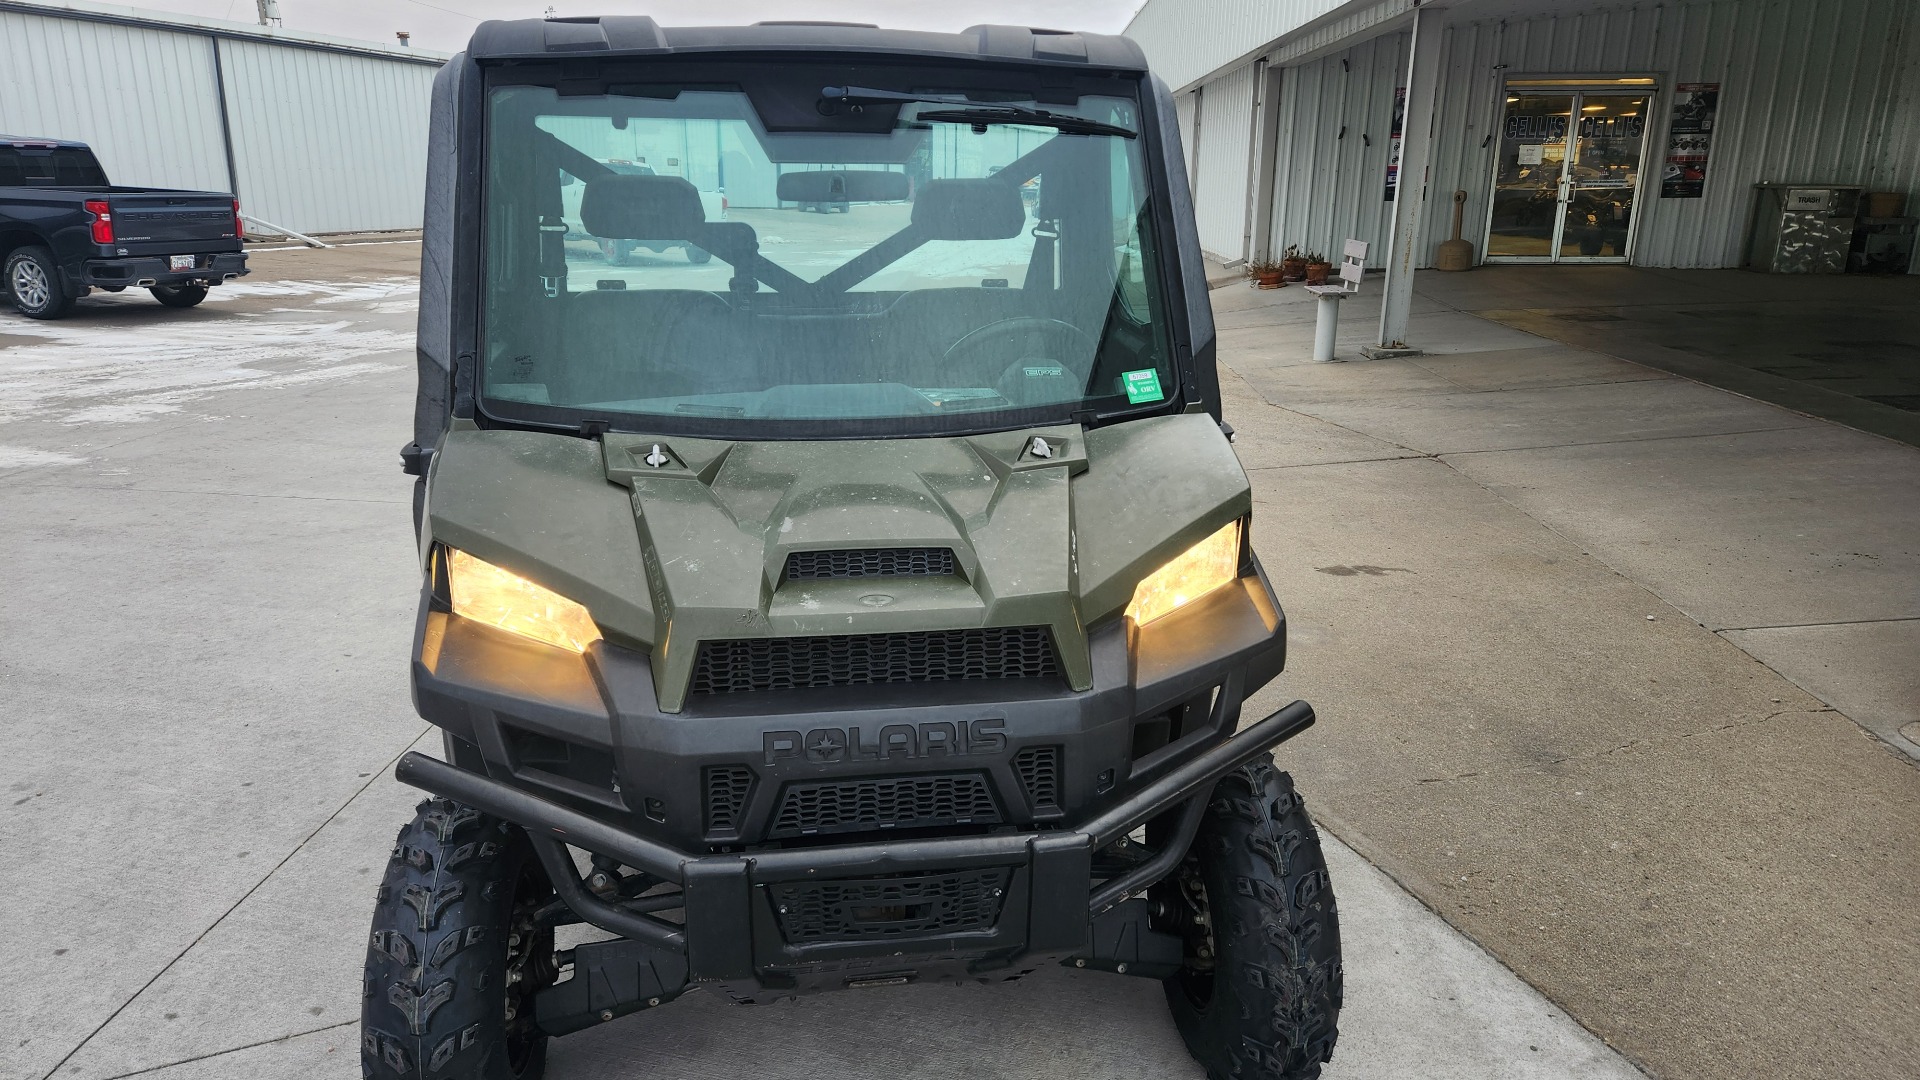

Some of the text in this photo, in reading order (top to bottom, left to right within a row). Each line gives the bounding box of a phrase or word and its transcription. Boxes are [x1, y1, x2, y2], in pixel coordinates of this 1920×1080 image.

[1505, 116, 1566, 139] CELLI'S
[1581, 116, 1643, 139] CELLI'S
[123, 212, 230, 222] CHEVROLET
[762, 718, 1007, 767] POLARIS
